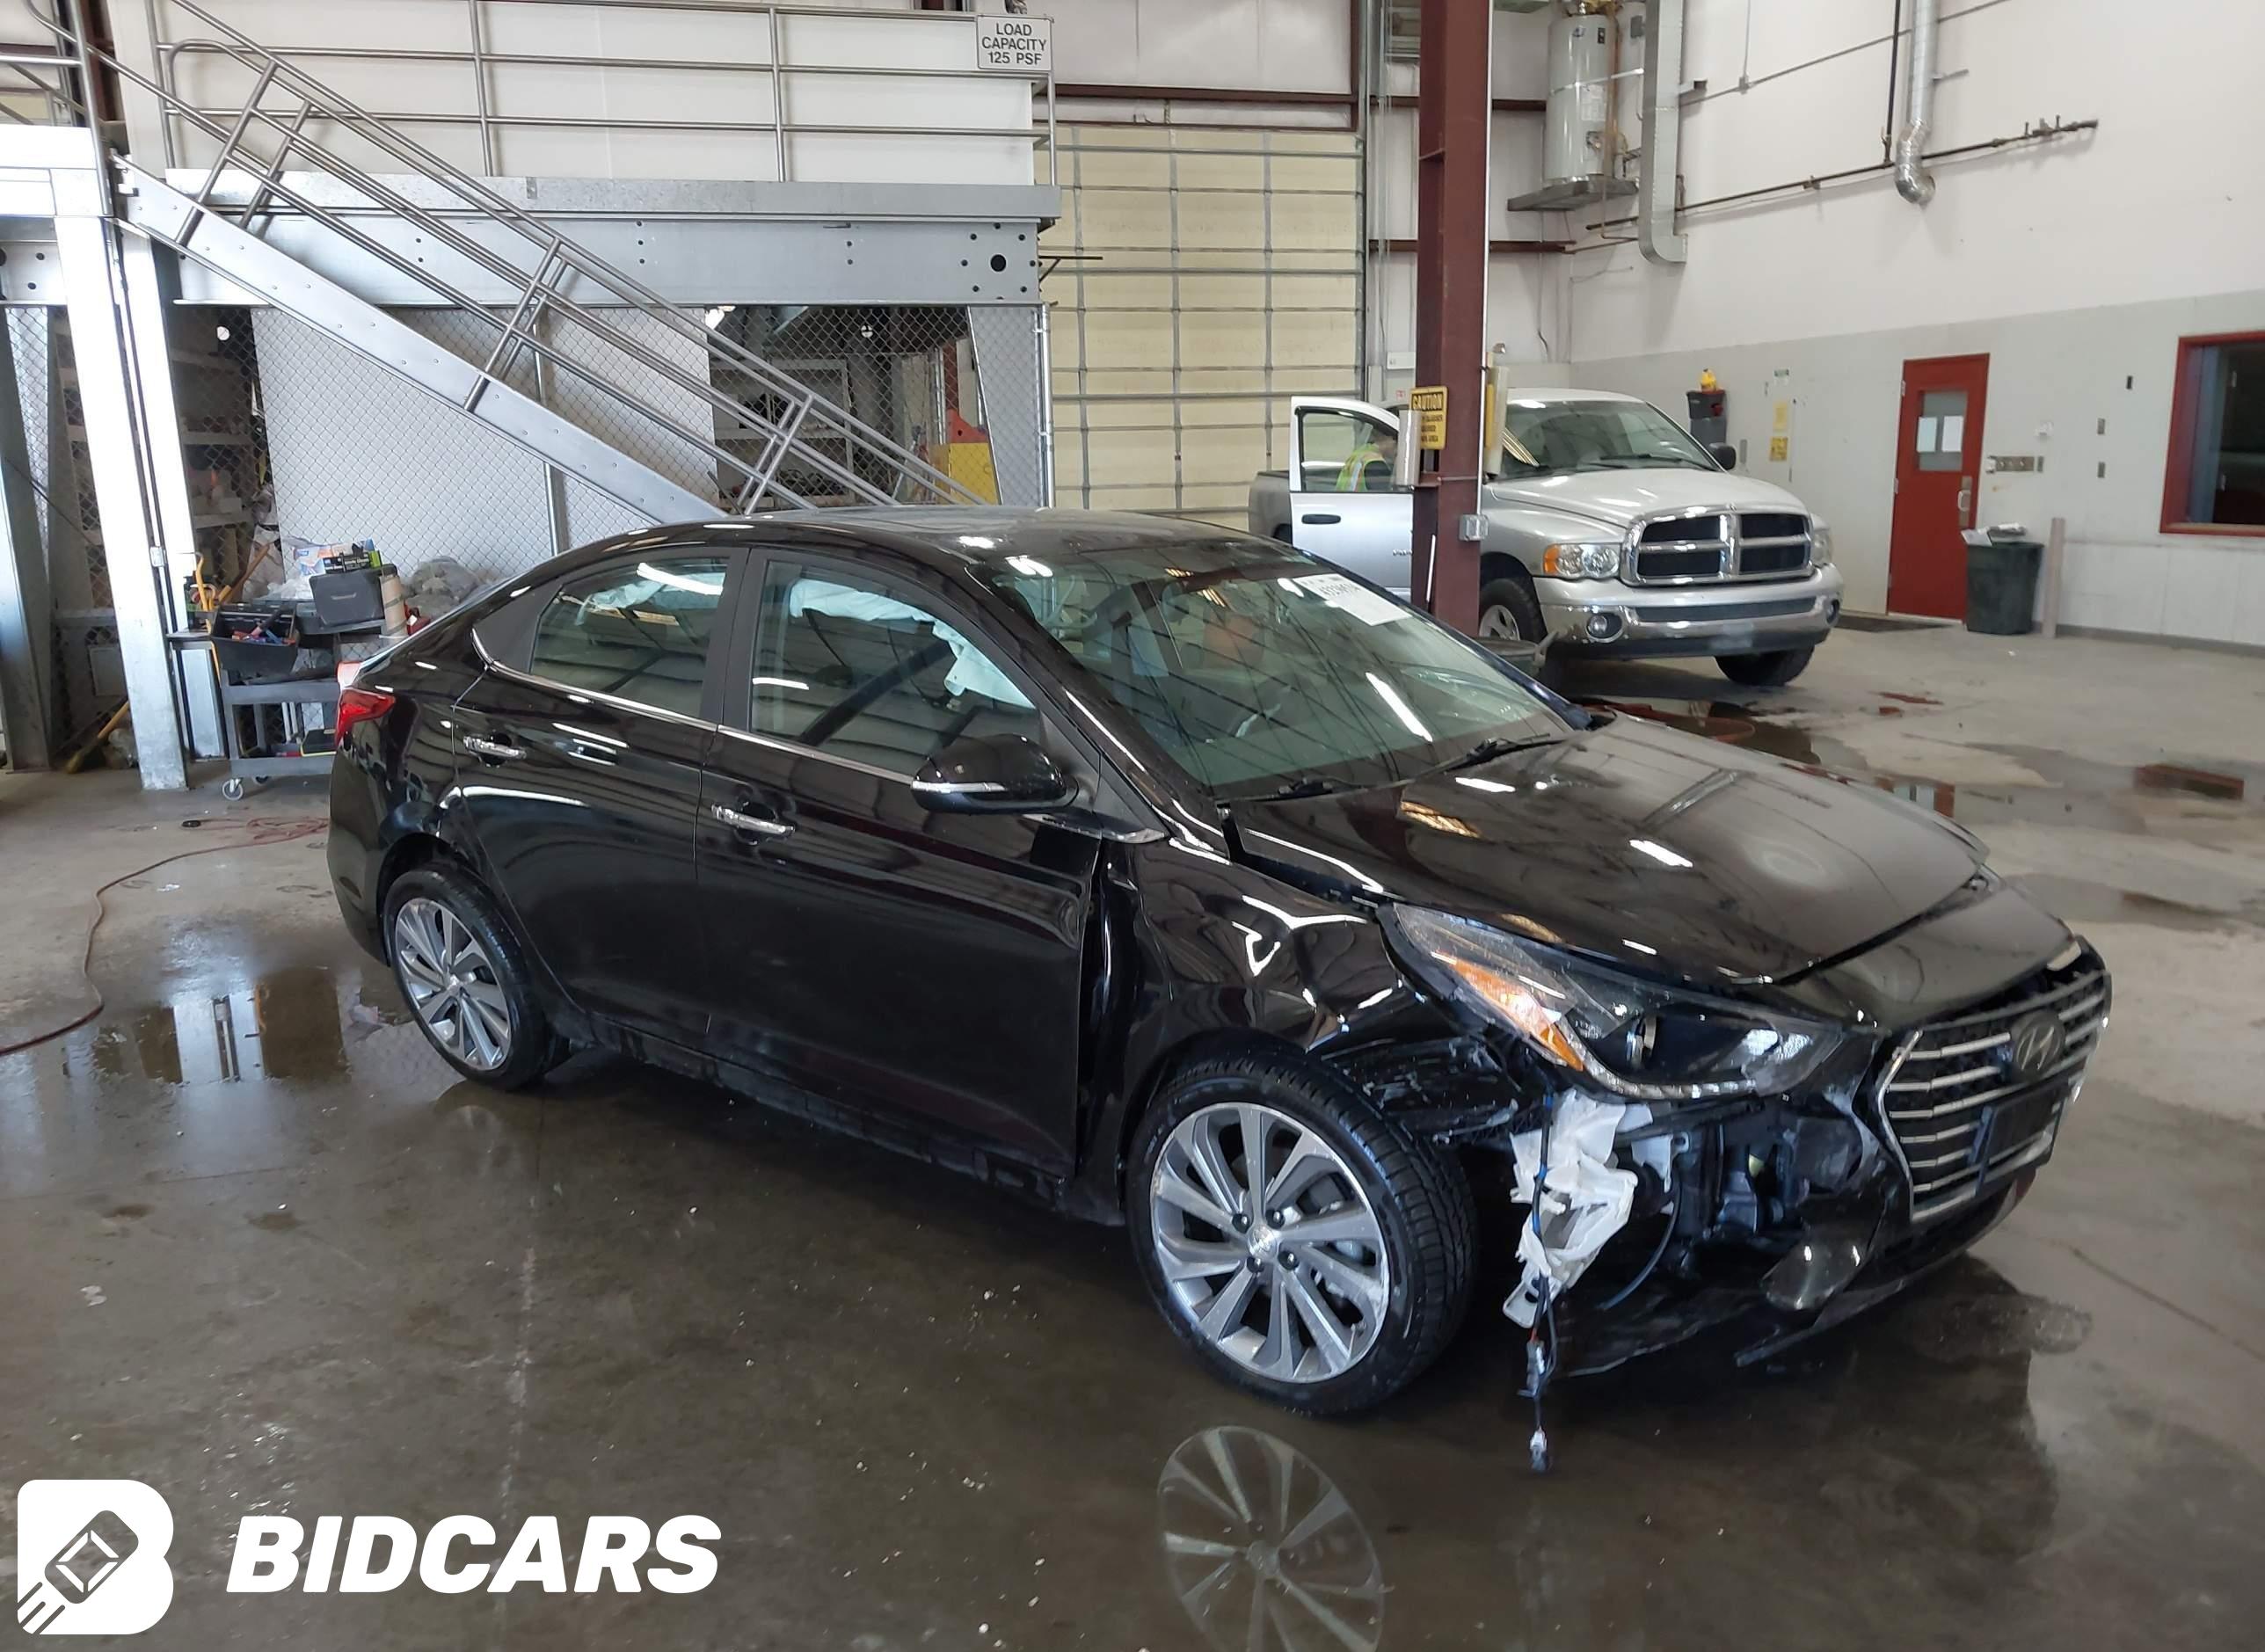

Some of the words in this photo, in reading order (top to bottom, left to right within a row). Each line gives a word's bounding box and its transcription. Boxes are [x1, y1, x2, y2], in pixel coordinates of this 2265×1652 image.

[996, 23, 1032, 36] LOAD
[981, 37, 1046, 51] CAPACITY
[988, 52, 1010, 64] 125
[1016, 53, 1042, 65] PSF
[1412, 392, 1443, 411] CAUTION
